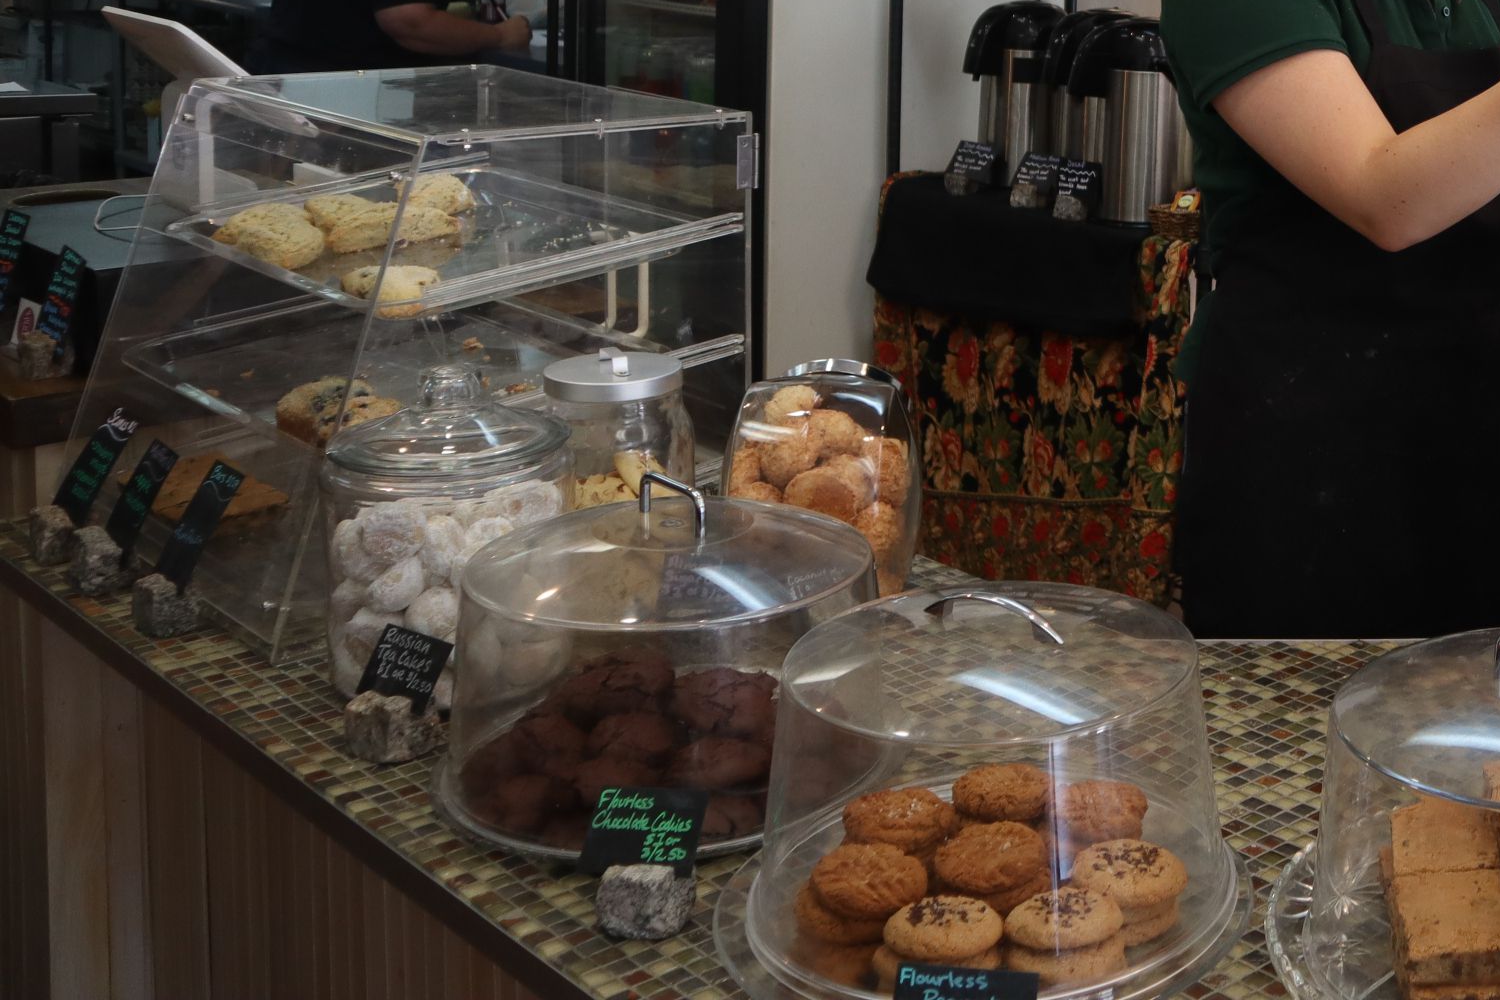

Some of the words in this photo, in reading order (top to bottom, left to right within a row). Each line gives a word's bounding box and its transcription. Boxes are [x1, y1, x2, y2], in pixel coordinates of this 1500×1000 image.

[384, 627, 432, 654] Russian
[378, 644, 397, 661] Tea
[397, 650, 432, 673] Cakes
[900, 967, 989, 990] Flourless
